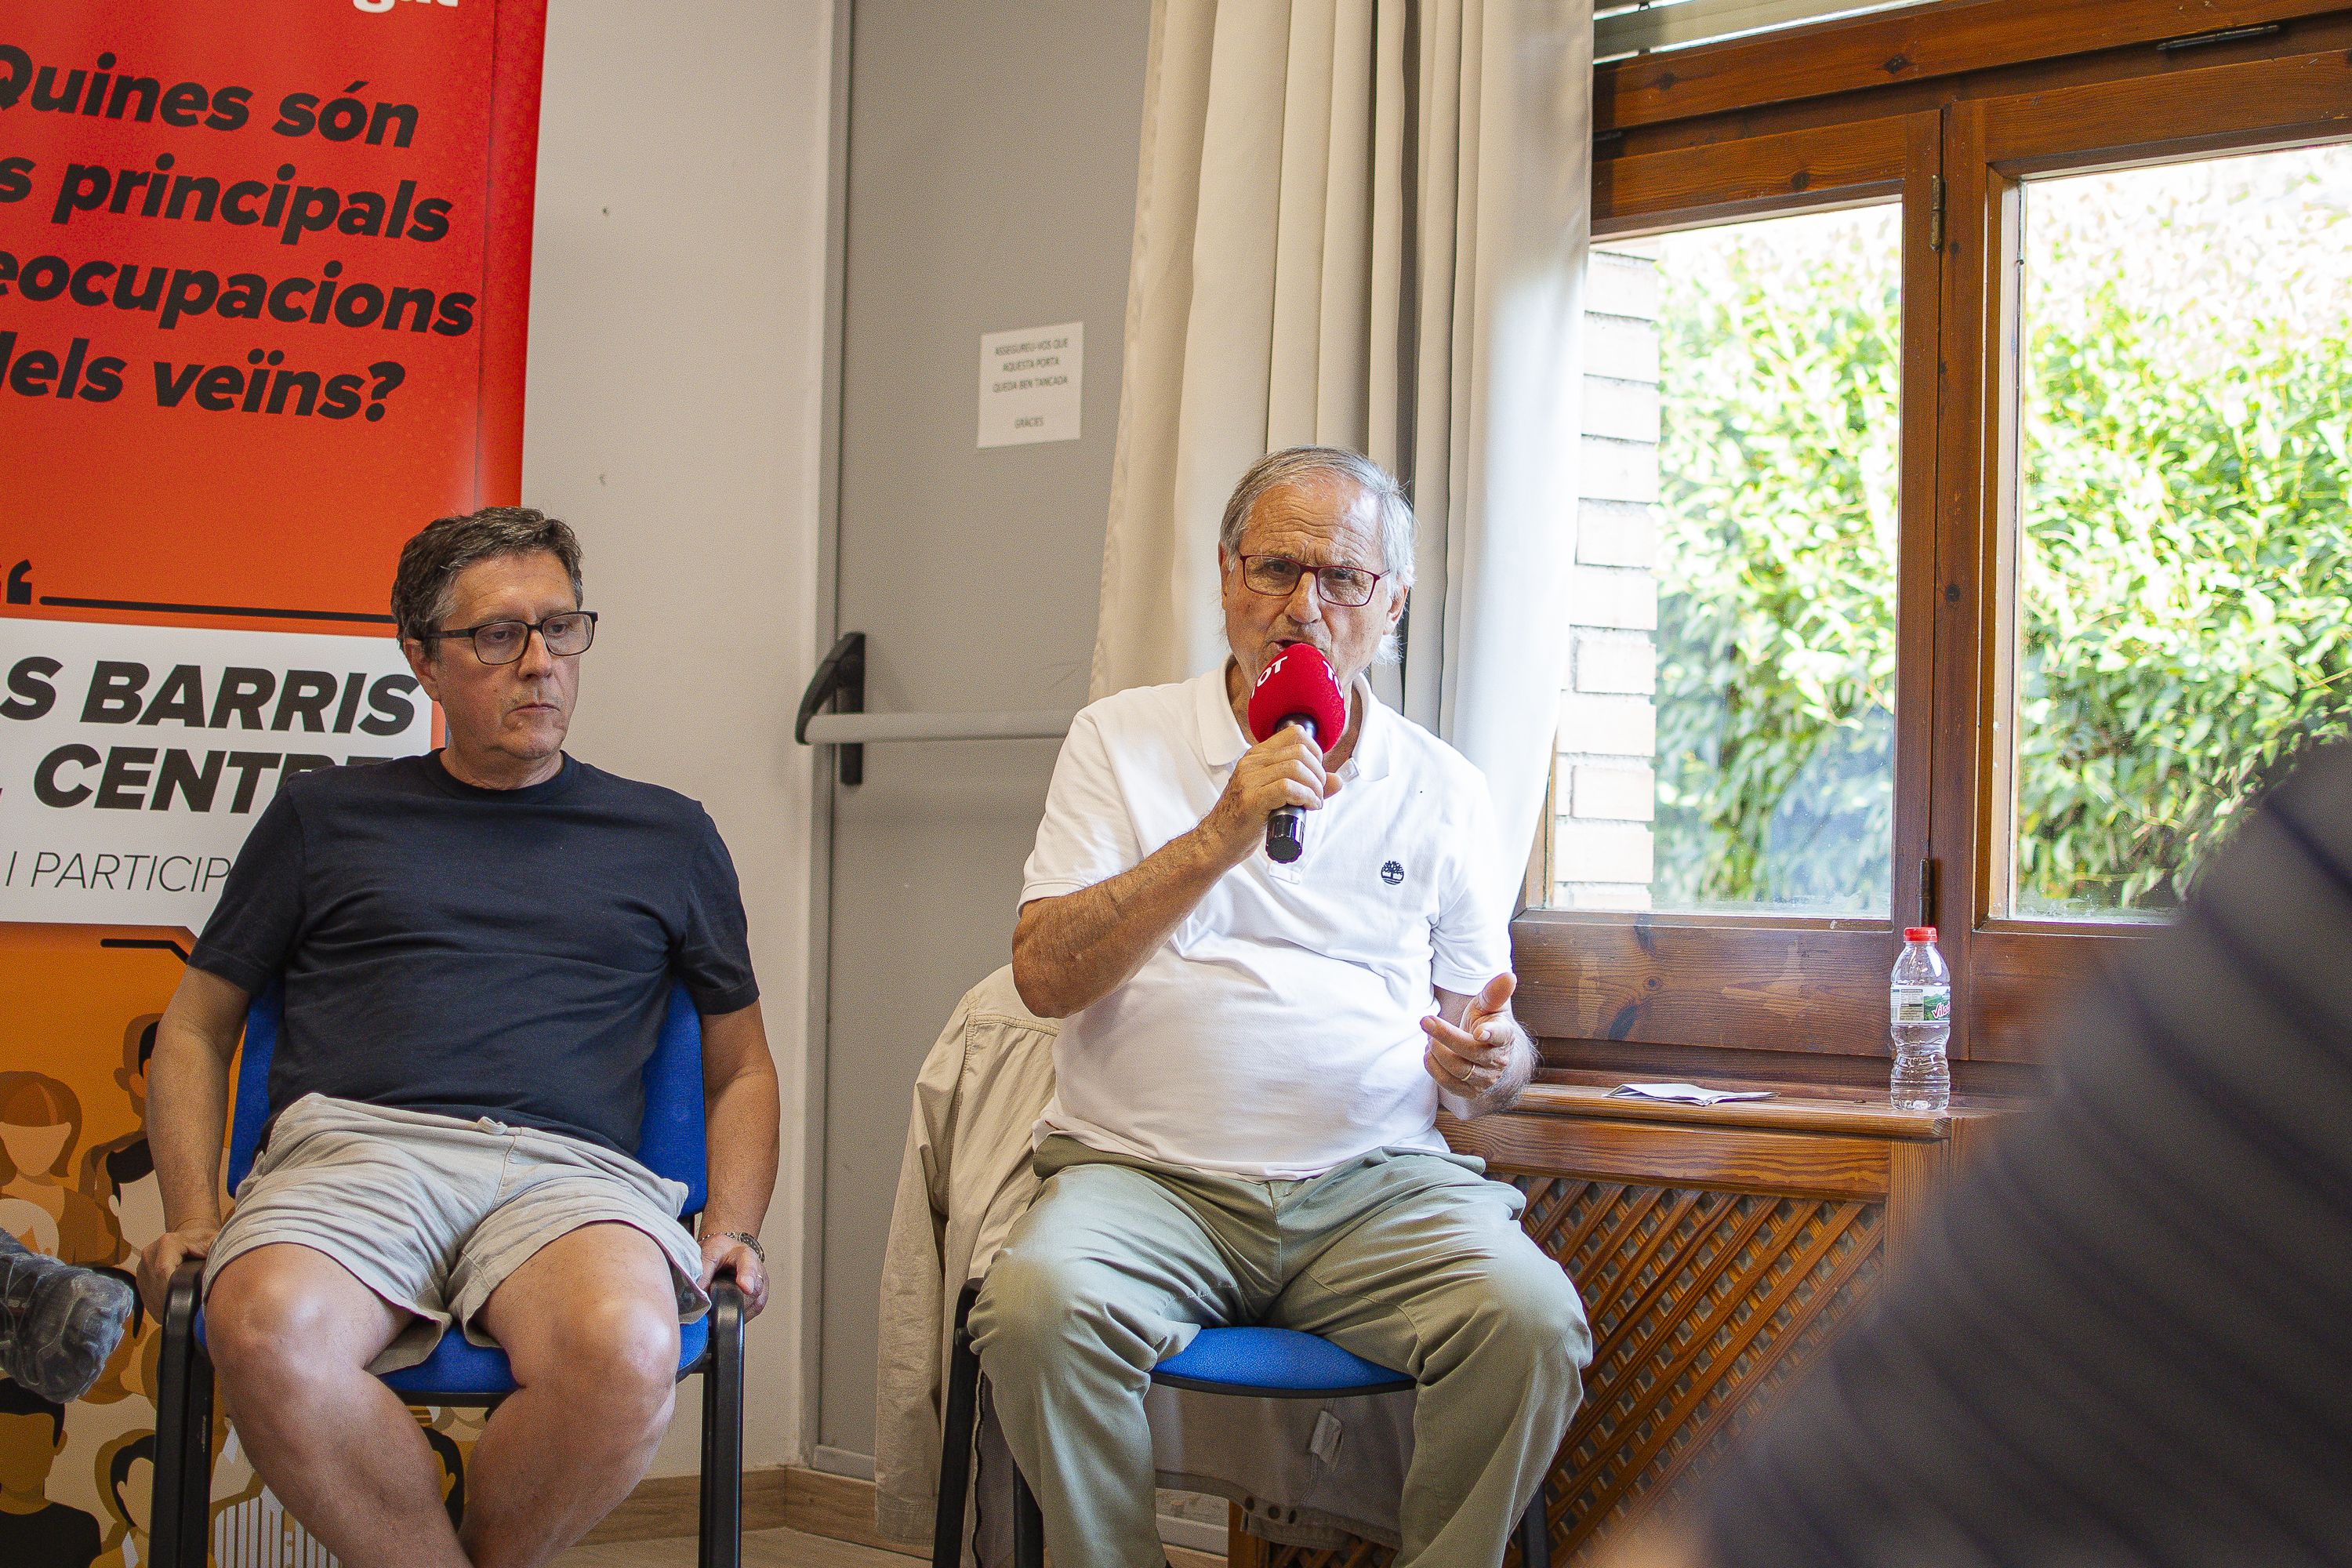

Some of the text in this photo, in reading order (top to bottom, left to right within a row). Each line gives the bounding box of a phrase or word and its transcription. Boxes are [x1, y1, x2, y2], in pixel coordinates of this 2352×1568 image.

[0, 44, 419, 147] Quines són
[52, 153, 452, 245] principals
[0, 331, 405, 422] els veïns?
[1036, 357, 1059, 368] PORTA
[0, 656, 421, 735] S BARRIS
[34, 743, 393, 814] CENT
